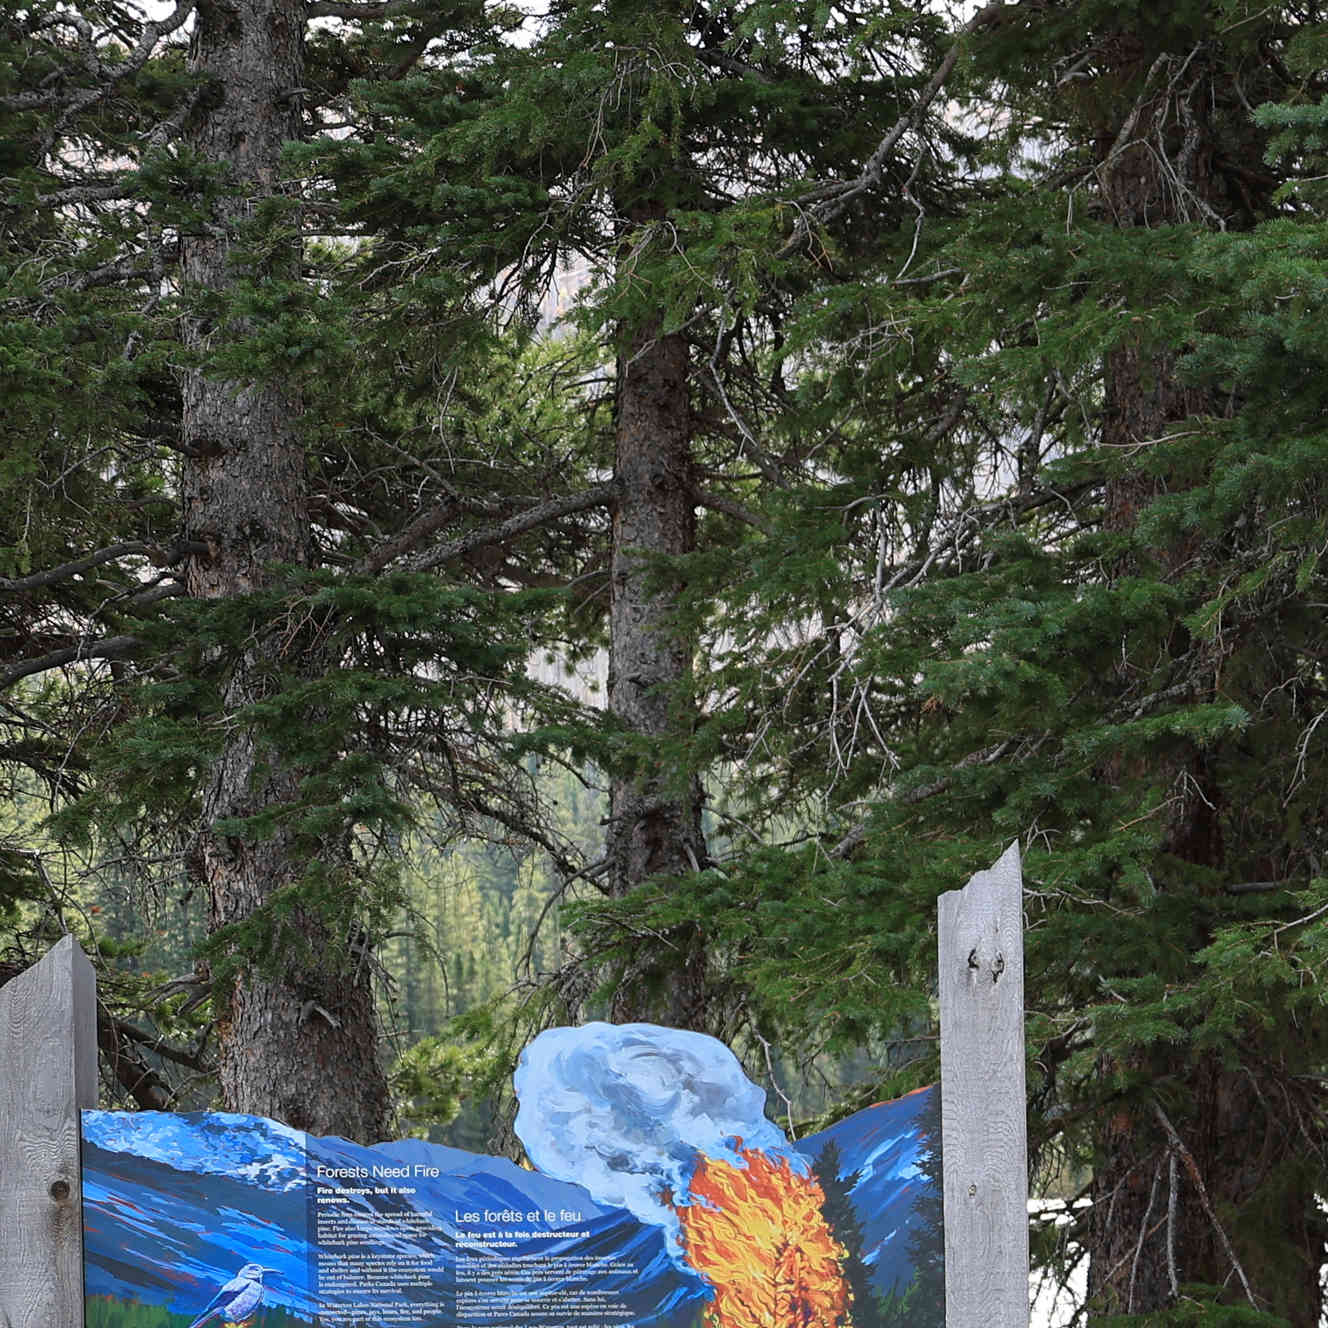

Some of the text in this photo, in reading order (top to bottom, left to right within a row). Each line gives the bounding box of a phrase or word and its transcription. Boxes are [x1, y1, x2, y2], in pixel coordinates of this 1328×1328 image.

[317, 1165, 440, 1179] Forests Need Fire
[335, 1187, 373, 1196] destroys,
[456, 1209, 583, 1223] Les forêts et le feu
